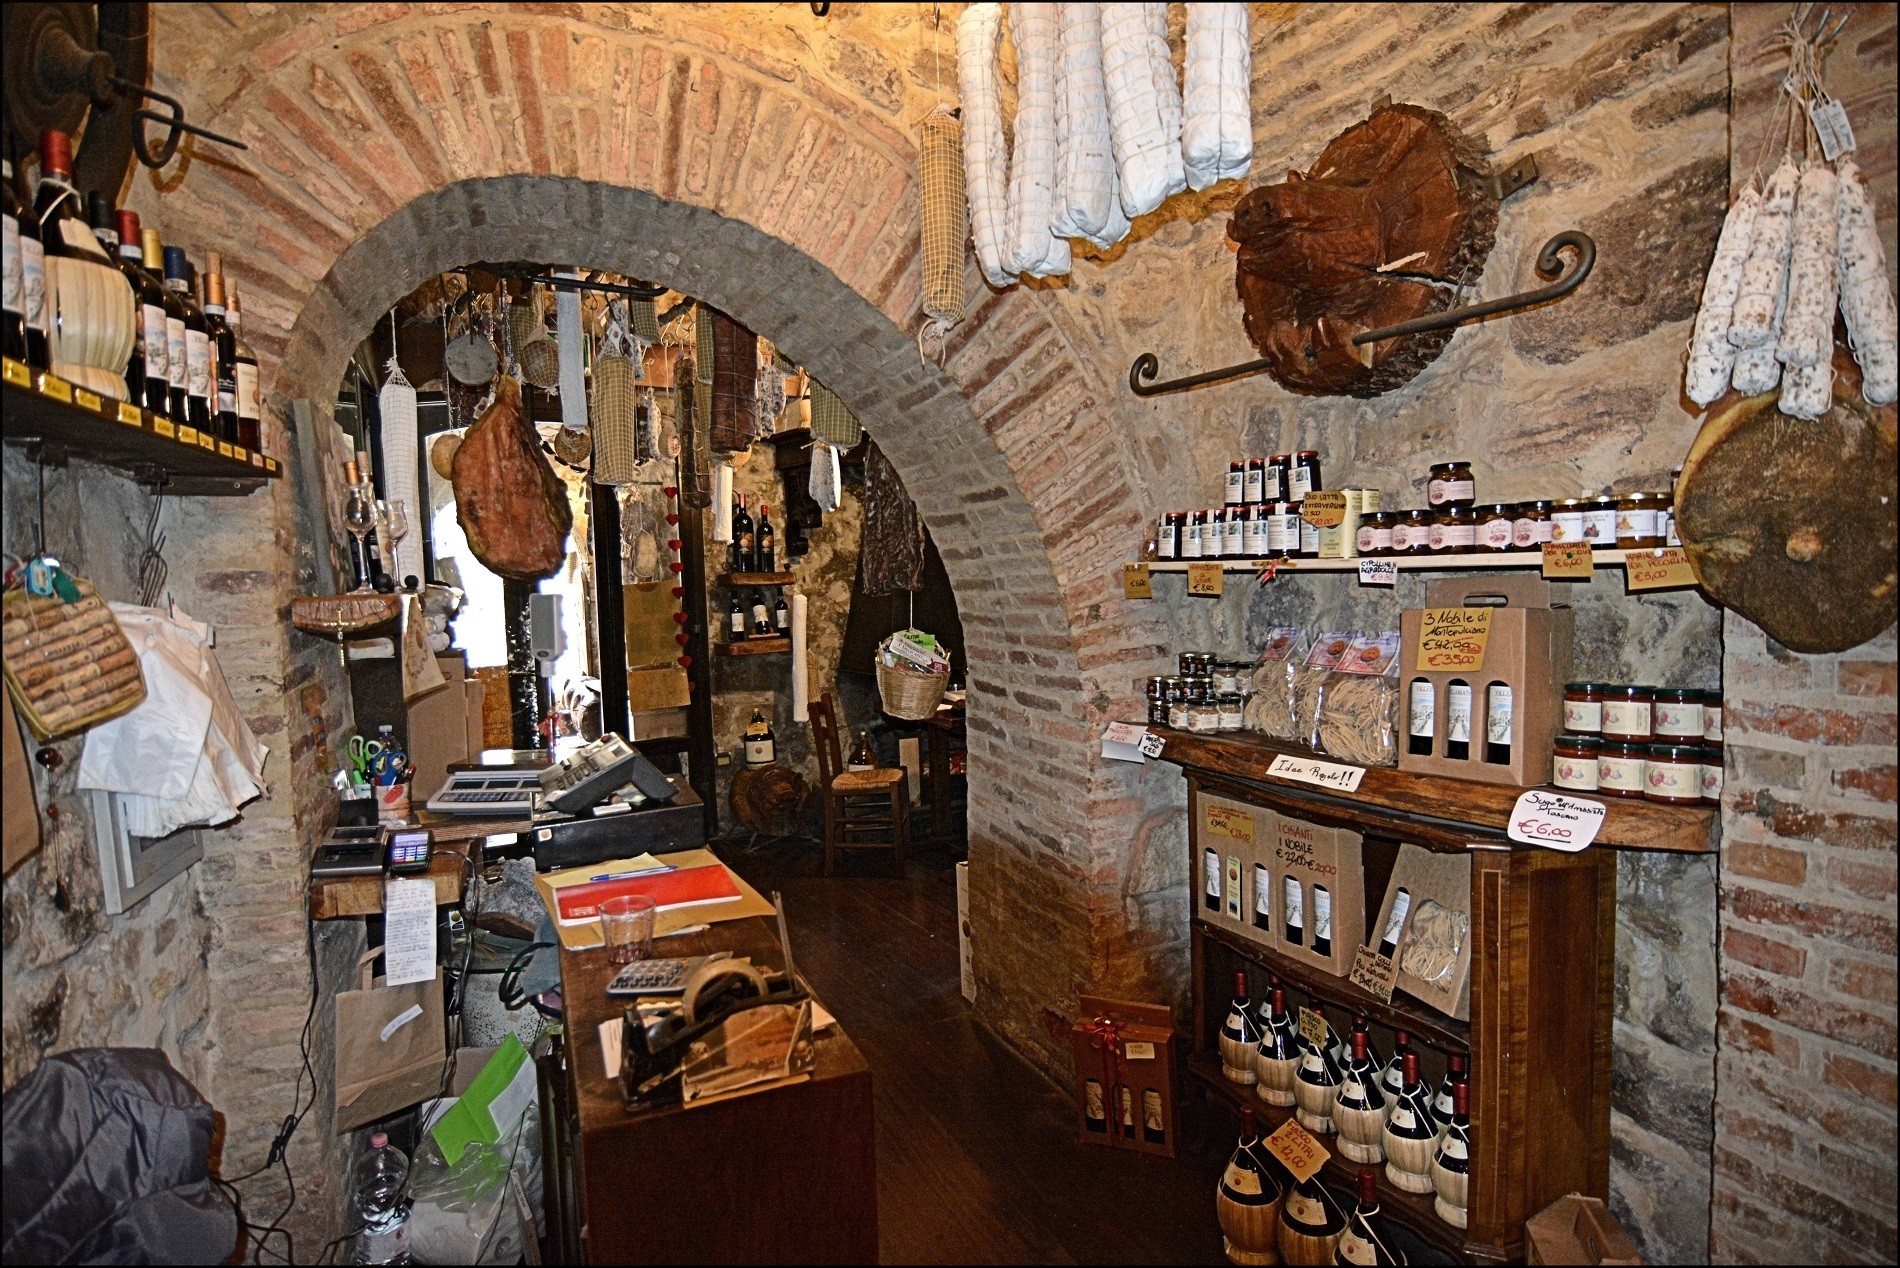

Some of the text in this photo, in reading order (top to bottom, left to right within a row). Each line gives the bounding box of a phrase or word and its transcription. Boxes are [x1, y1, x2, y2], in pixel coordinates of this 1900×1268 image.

[1319, 493, 1339, 501] LATTA
[1634, 569, 1667, 581] €5,00
[1424, 609, 1489, 626] 3 Nobile di
[1424, 624, 1487, 637] Montepulciano
[1422, 638, 1471, 651] €42,00
[1427, 653, 1475, 667] €35,00
[1274, 759, 1302, 773] Idee
[1525, 793, 1556, 810] Sugo
[1547, 808, 1579, 821] Toscano
[1517, 819, 1572, 838] €6,00
[1285, 837, 1314, 855] NOBILE
[1286, 1120, 1312, 1145] FIASCO
[1291, 1136, 1315, 1160] LITRI
